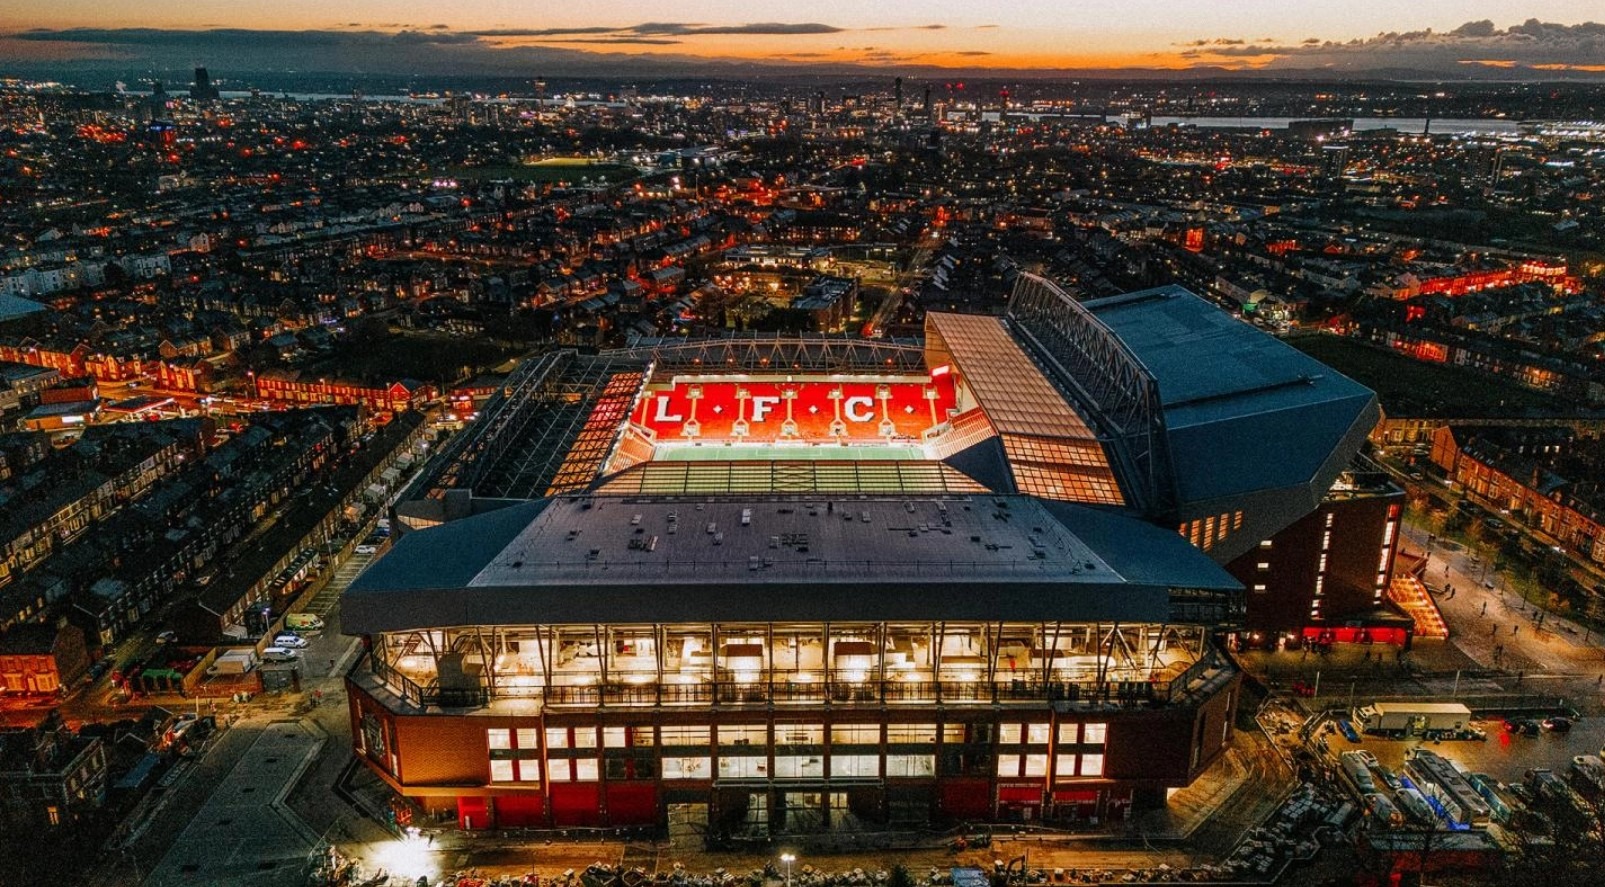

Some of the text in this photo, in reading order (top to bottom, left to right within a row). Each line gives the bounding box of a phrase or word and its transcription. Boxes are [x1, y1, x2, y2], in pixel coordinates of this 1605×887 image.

[654, 396, 874, 422] L F C
